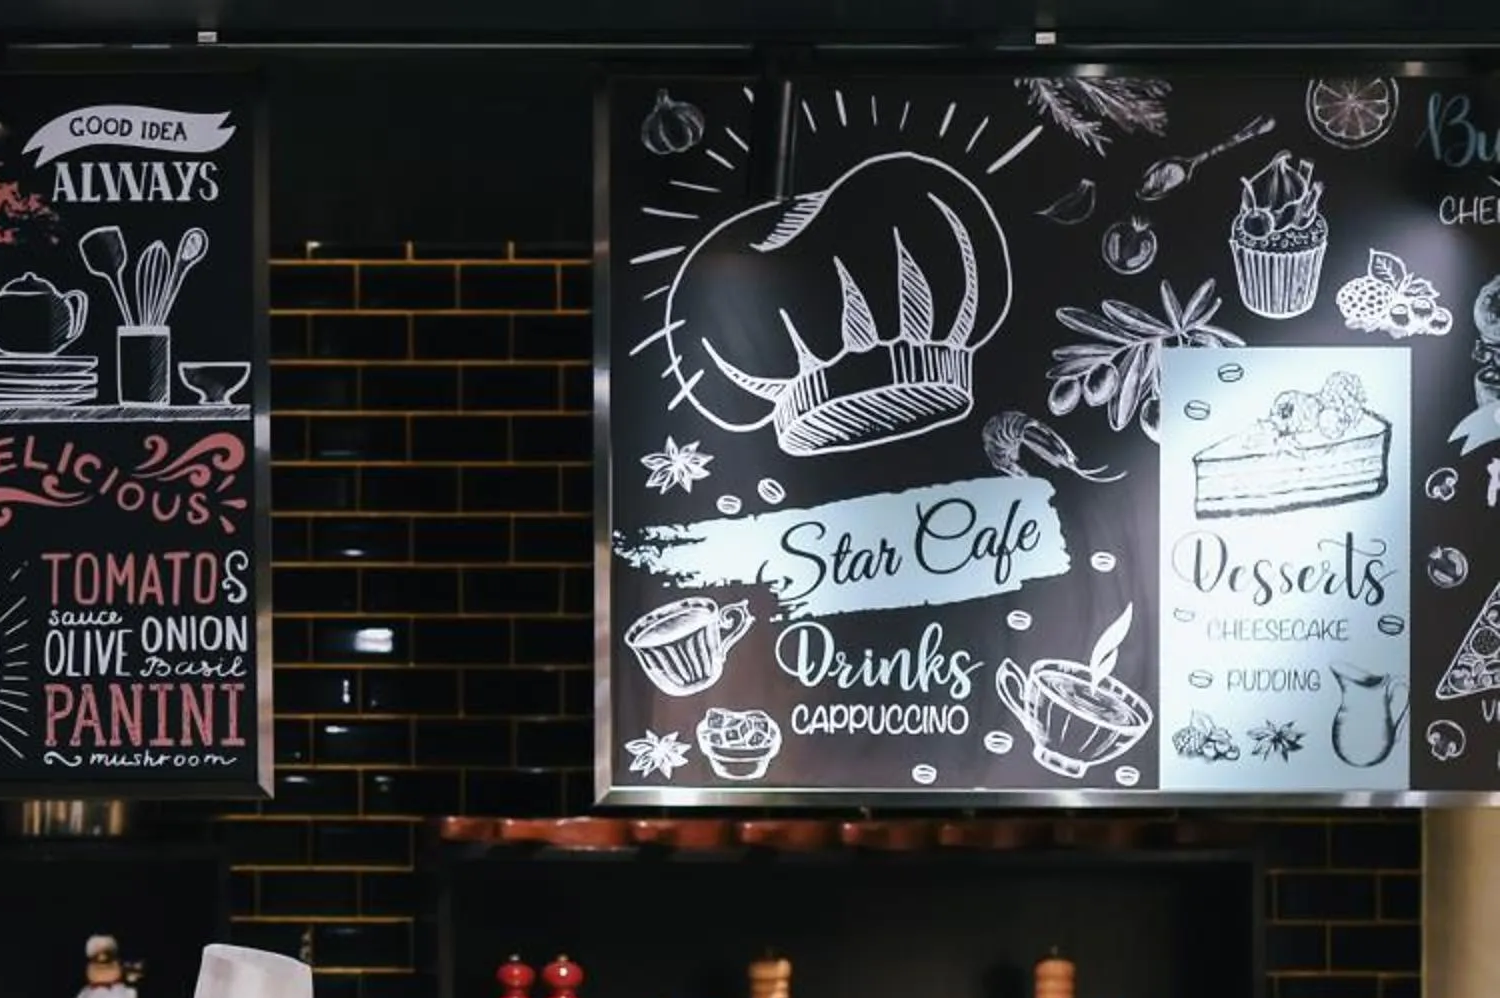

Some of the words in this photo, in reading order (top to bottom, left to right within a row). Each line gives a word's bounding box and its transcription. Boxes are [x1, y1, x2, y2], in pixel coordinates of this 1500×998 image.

[68, 116, 133, 137] GOOD
[141, 121, 188, 142] IDEA
[52, 161, 219, 202] ALWAYS
[1439, 195, 1500, 225] CHE
[756, 521, 904, 601] Star
[914, 497, 1041, 585] Cafe
[1172, 530, 1398, 606] Desserts
[48, 609, 123, 626] sauce
[1207, 618, 1349, 641] CHEESECAKE
[141, 615, 247, 653] ONION
[45, 629, 132, 677] OLIVE
[140, 656, 246, 677] Basil
[775, 621, 986, 699] Drinks
[1227, 669, 1321, 691] PUDDING
[44, 683, 245, 746] PANINI
[791, 704, 970, 735] CAPPUCCINO
[90, 750, 237, 767] mushroom
